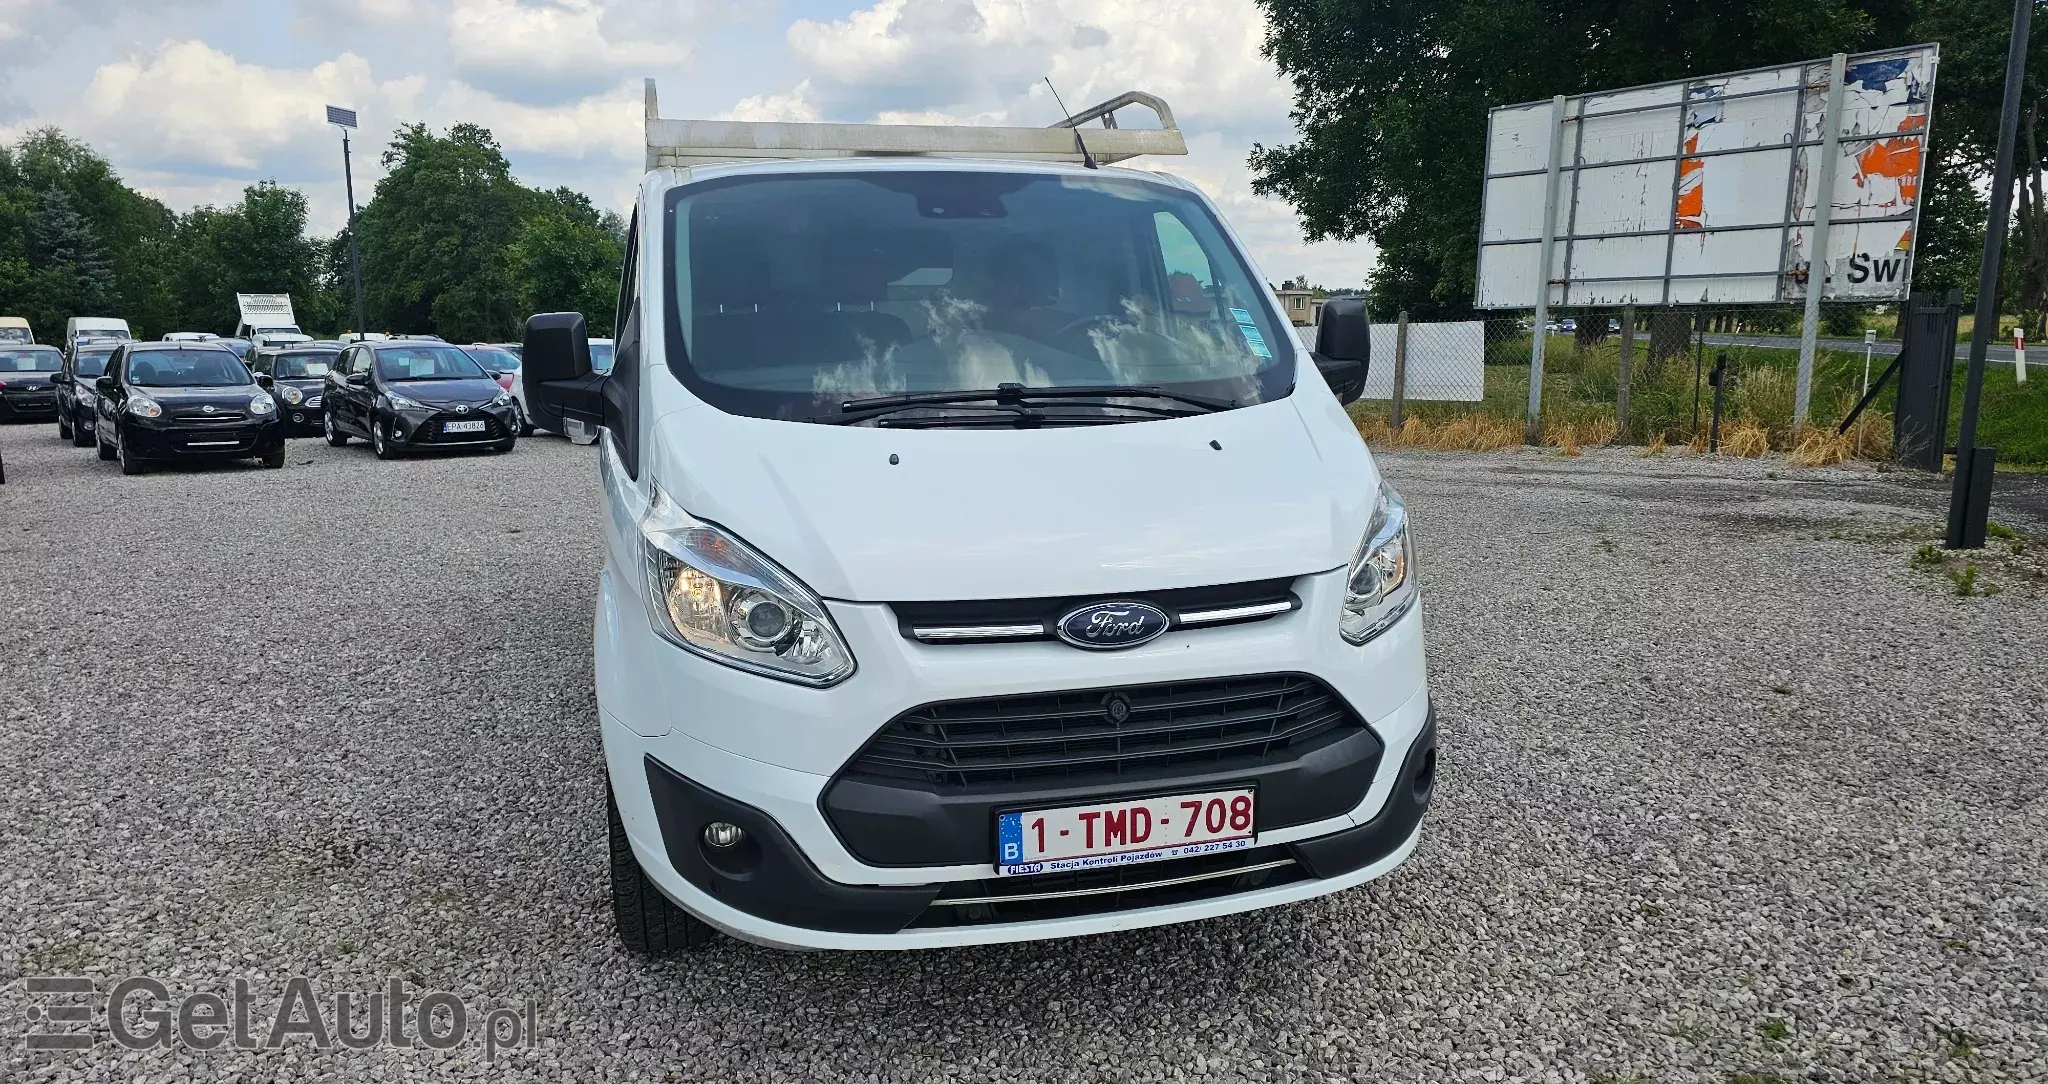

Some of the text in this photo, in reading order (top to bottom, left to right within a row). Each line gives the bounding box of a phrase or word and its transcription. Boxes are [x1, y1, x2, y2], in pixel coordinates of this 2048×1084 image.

[447, 422, 461, 431] EPA
[1086, 610, 1145, 638] Ford
[1004, 842, 1019, 860] B
[1050, 860, 1080, 870] Stacja
[1082, 855, 1119, 866] Kontroli
[1120, 851, 1163, 863] Pojazdów
[1204, 843, 1220, 852] 227
[1222, 842, 1233, 850] 54
[1235, 840, 1246, 848] 30
[1010, 863, 1041, 875] FIESTA
